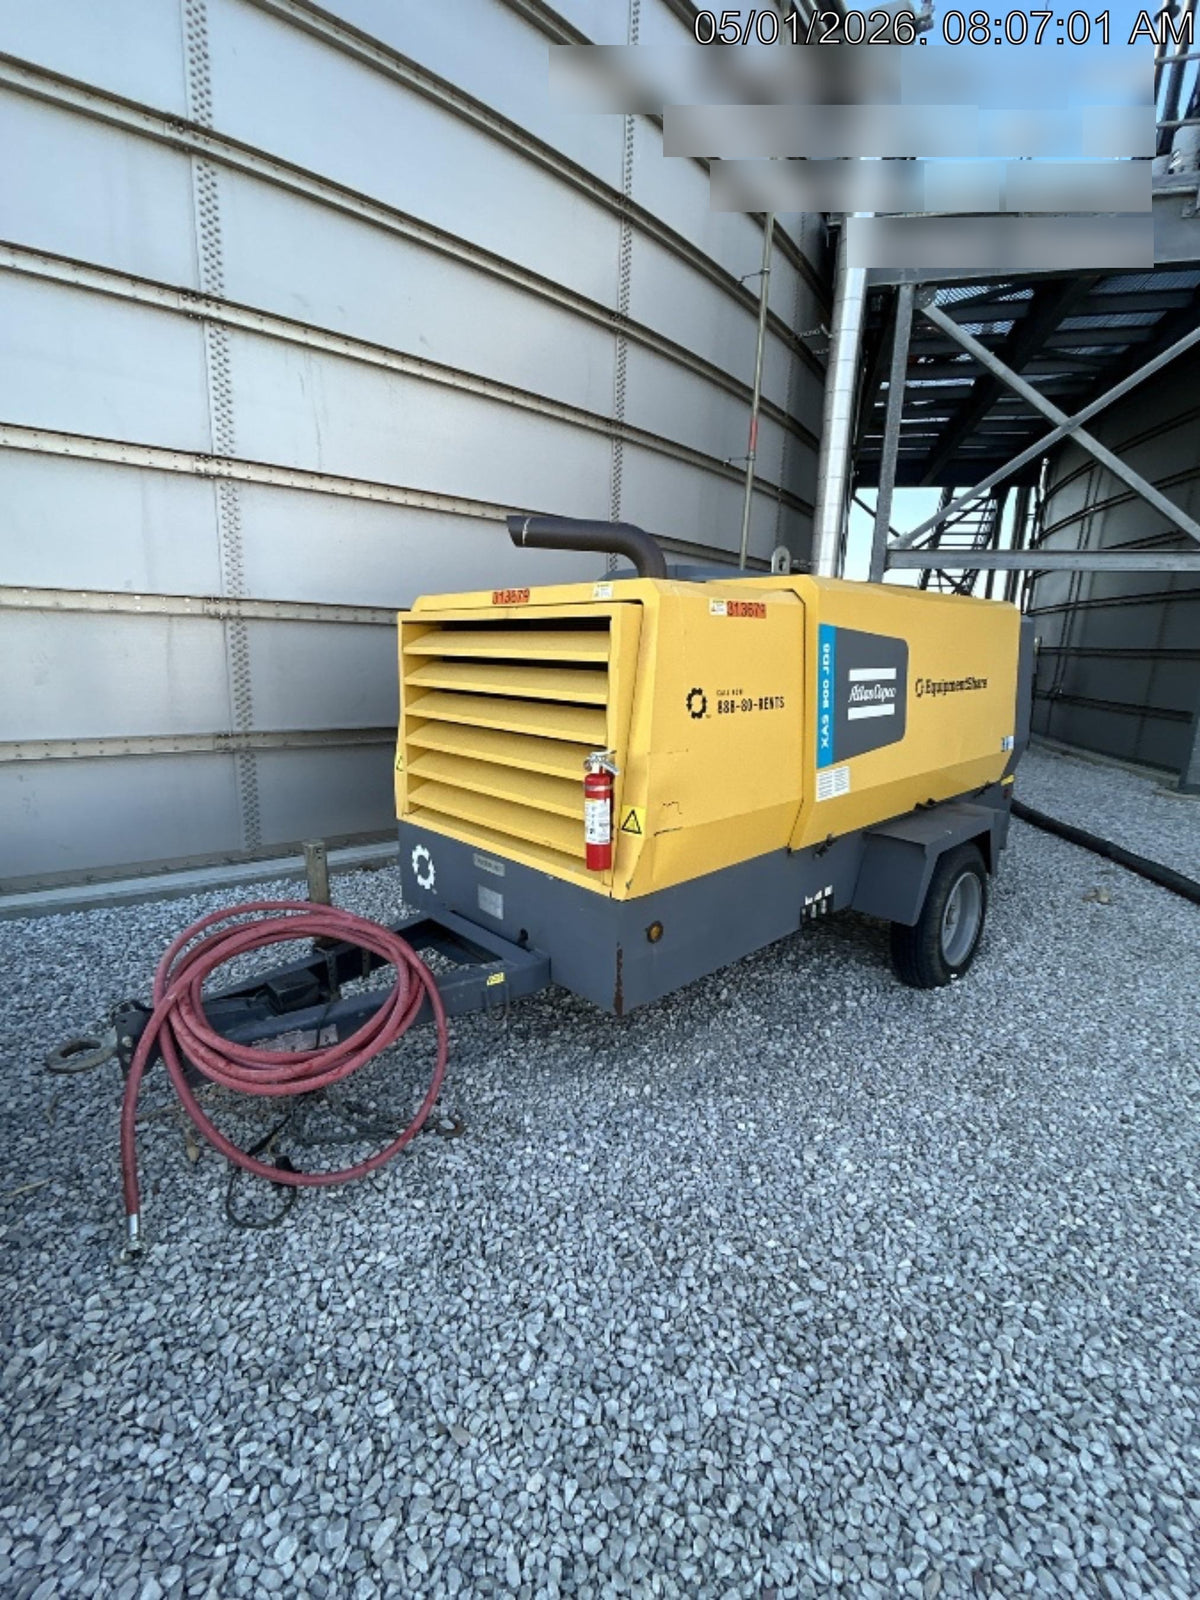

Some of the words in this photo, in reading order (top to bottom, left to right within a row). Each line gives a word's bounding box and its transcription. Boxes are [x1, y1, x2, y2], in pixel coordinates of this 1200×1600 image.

[822, 679, 830, 709] 900
[848, 684, 874, 703] Atlas
[874, 684, 897, 702] Copco
[925, 677, 988, 697] EquipmentShare
[821, 714, 830, 749] XAS
